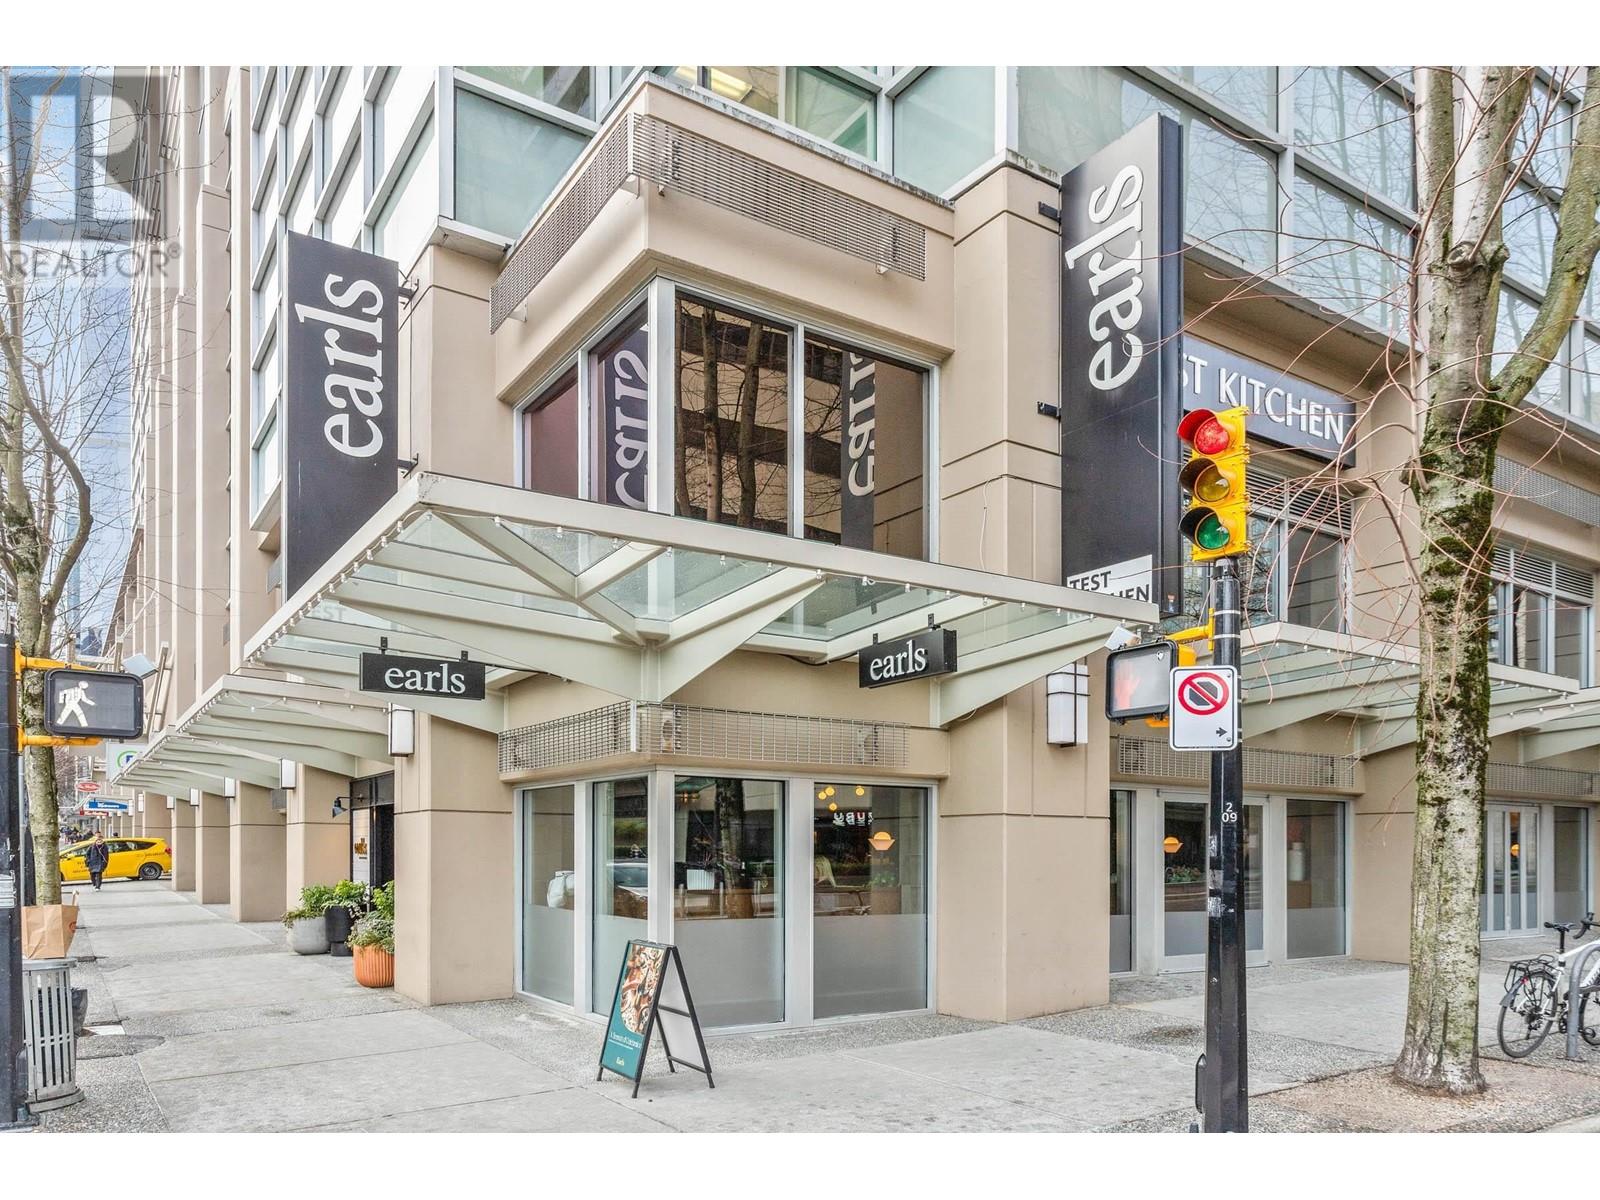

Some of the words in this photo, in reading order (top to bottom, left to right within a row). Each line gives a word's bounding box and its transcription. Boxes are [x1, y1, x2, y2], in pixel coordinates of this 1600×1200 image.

[1064, 164, 1144, 390] earls
[294, 273, 384, 458] earls
[1219, 367, 1344, 444] KITCHEN
[384, 663, 466, 694] earls
[870, 639, 927, 681] earls
[1221, 812, 1238, 823] 09
[1225, 802, 1233, 812] 2
